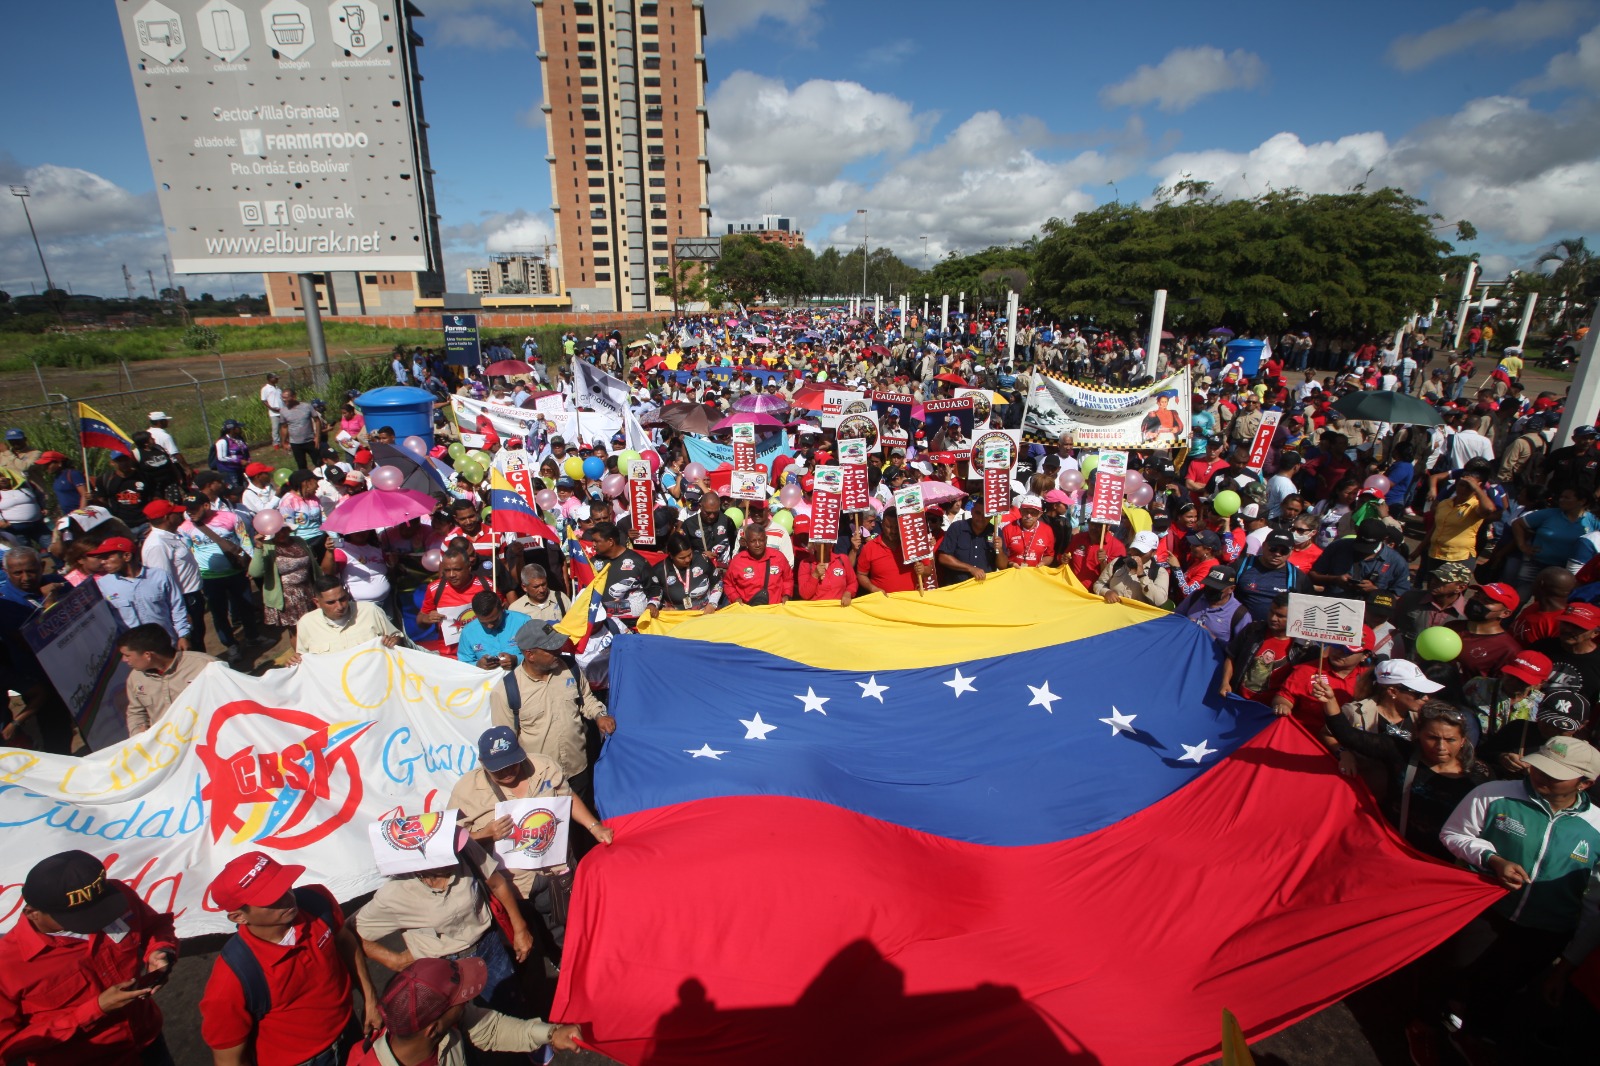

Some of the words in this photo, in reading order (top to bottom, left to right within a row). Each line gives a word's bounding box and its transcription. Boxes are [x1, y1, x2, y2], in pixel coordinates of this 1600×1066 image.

[213, 62, 247, 72] celulares
[278, 59, 311, 71] bodegón
[331, 57, 392, 68] electrodomésticos
[213, 106, 254, 122] Sector
[254, 105, 284, 121] Villa
[284, 104, 340, 120] Granada
[193, 136, 203, 149] al
[202, 136, 224, 148] lado
[224, 136, 238, 147] de:
[265, 132, 369, 150] FARMATODO
[230, 162, 252, 175] Pto.
[287, 161, 310, 174] Edo
[310, 159, 350, 173] Bolívar
[291, 203, 355, 224] @burak
[205, 230, 380, 254] www.elburak.net
[875, 392, 912, 403] CAUJARO
[926, 399, 970, 411] CAUJARO
[881, 438, 907, 446] MADURO
[1251, 429, 1270, 464] PIAR
[854, 469, 867, 503] BOLIVAR
[997, 473, 1008, 507] BOLIVAR
[1108, 480, 1122, 515] BOLIVAR
[634, 479, 651, 536] TRANSPORTE
[824, 498, 838, 534] BOLIVAR
[913, 517, 928, 552] BOLIVAR
[1301, 630, 1319, 639] VILLA
[230, 726, 331, 801] CBST
[520, 818, 553, 844] CBST
